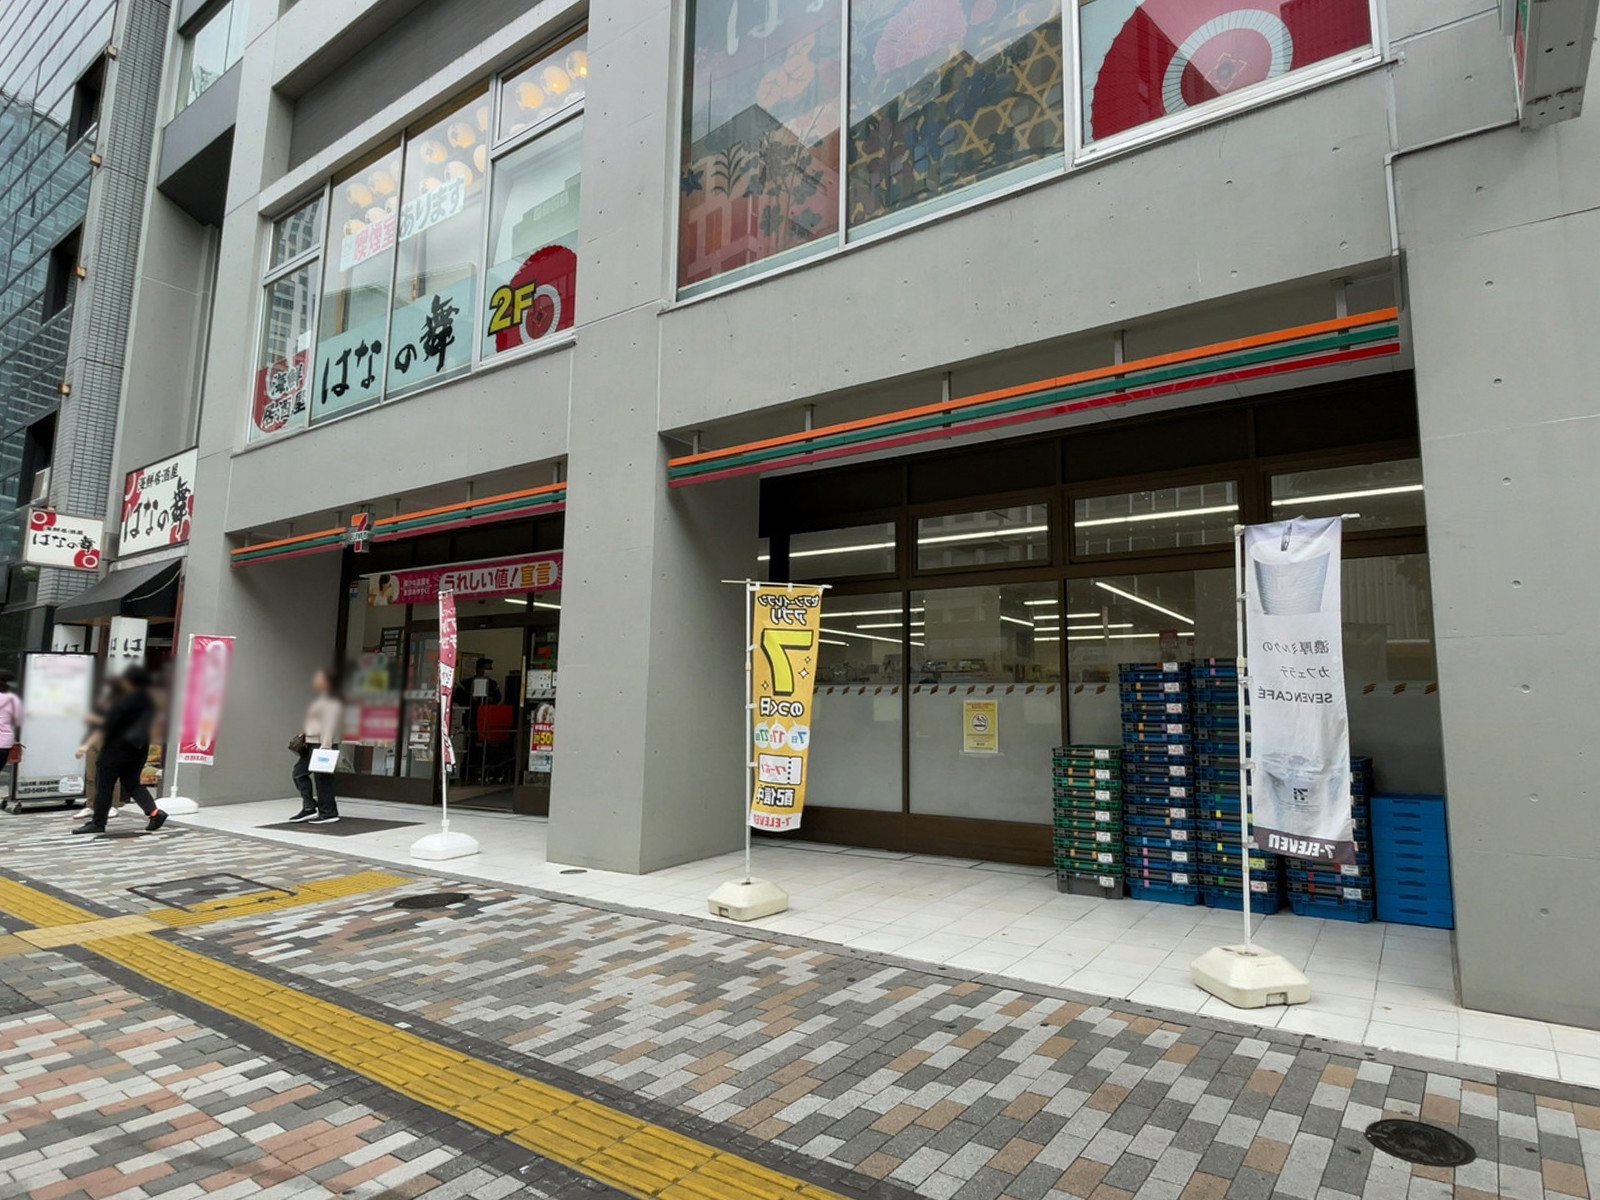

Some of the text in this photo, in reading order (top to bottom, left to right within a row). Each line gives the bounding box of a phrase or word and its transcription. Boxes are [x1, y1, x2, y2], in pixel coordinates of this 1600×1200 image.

[488, 279, 537, 337] 2F
[321, 294, 460, 404] はなの舞
[123, 476, 191, 543] はなの舞
[32, 533, 96, 553] はなの舞
